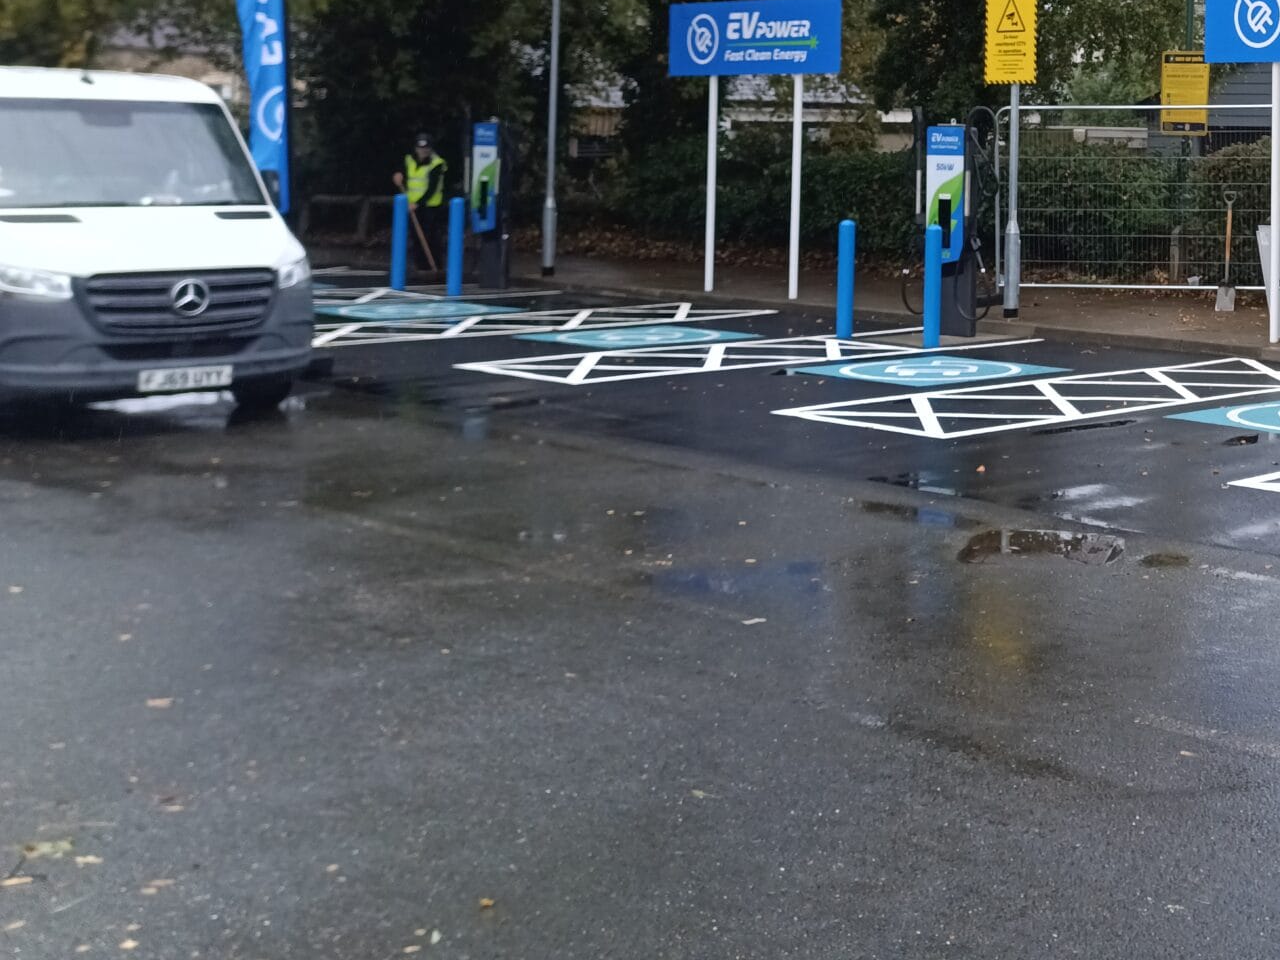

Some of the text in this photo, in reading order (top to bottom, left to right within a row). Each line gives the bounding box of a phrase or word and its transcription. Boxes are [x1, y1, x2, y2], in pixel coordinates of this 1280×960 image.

[724, 48, 808, 63] Fast Clean Energy
